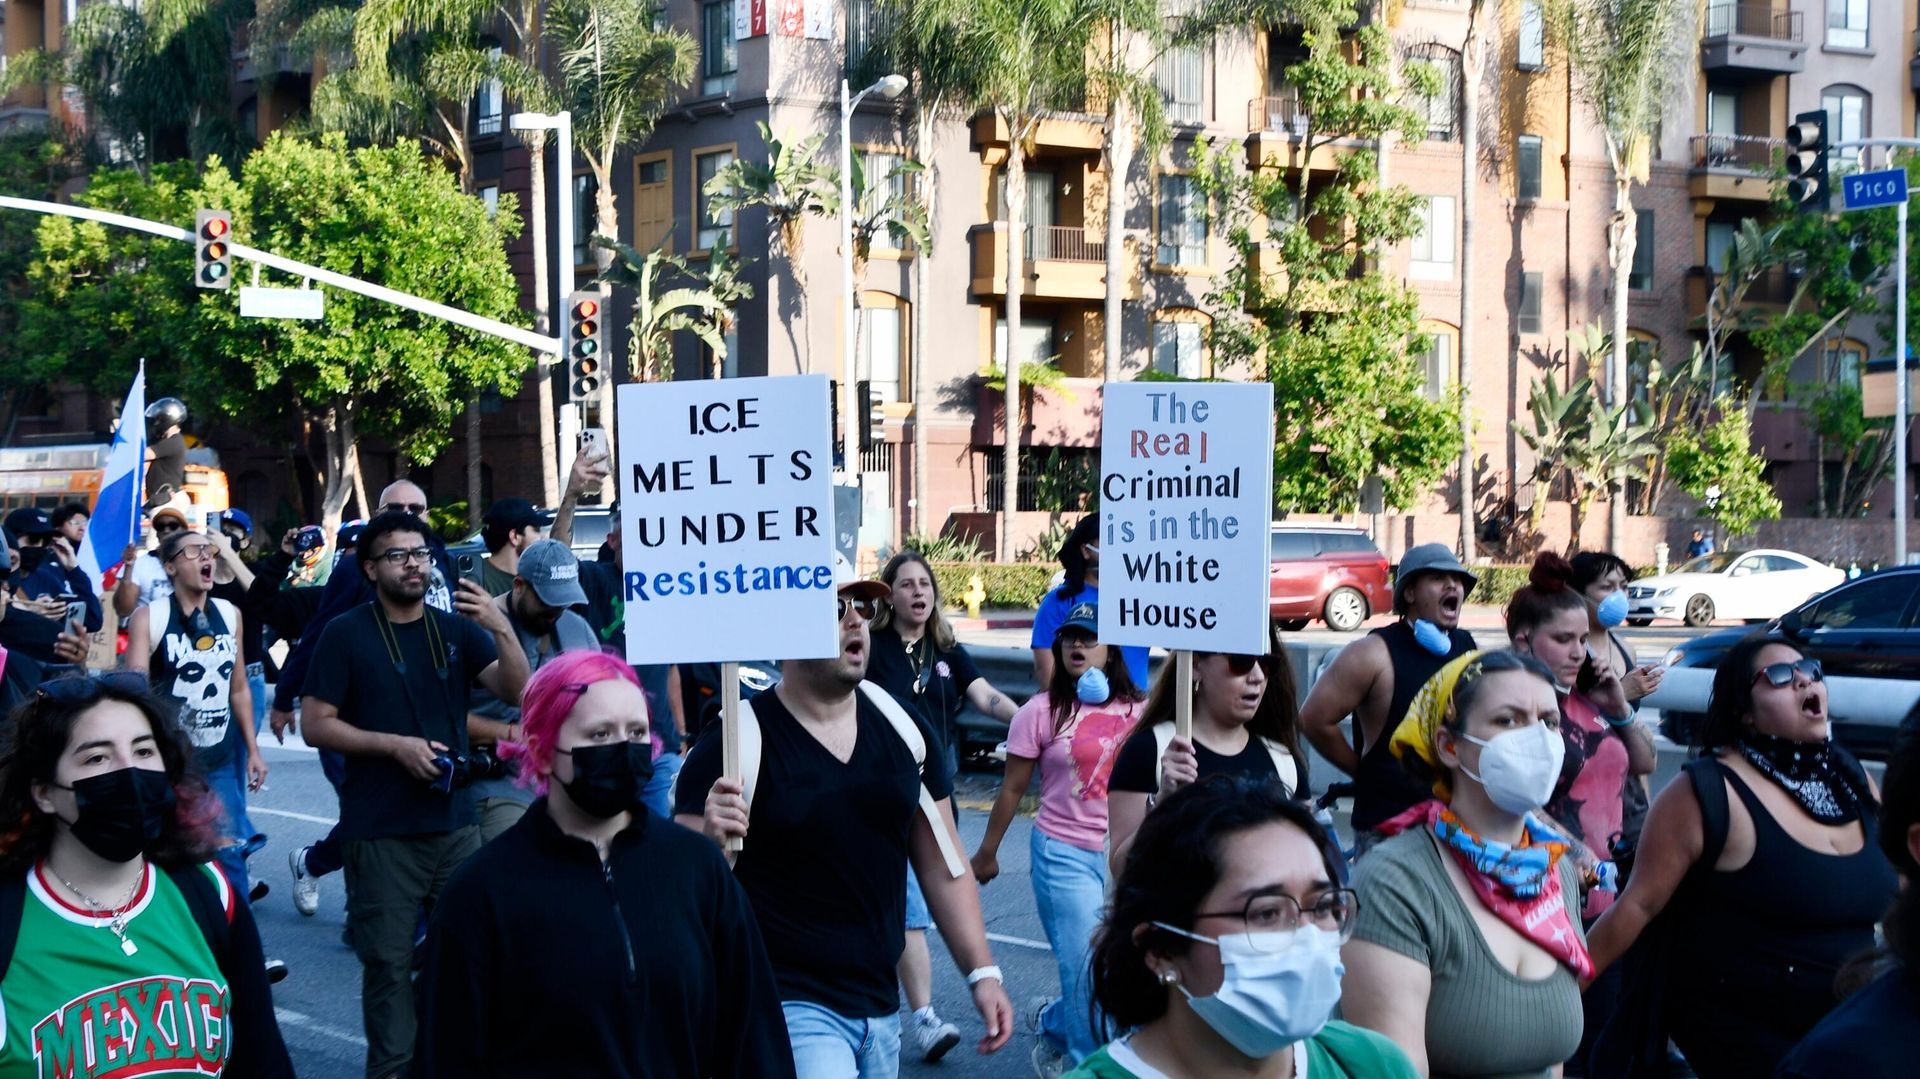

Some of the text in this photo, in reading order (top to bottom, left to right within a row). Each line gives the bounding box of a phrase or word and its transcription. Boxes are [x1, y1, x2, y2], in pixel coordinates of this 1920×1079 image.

[689, 398, 759, 435] I.C.E
[1146, 392, 1209, 424] The
[1131, 430, 1207, 464] Real
[633, 450, 812, 494] MELTS
[1103, 464, 1240, 502] Criminal
[639, 506, 820, 547] UNDER
[1107, 507, 1239, 545] is in the
[624, 561, 832, 601] Resistance
[1122, 550, 1220, 584] White
[1120, 598, 1217, 630] House
